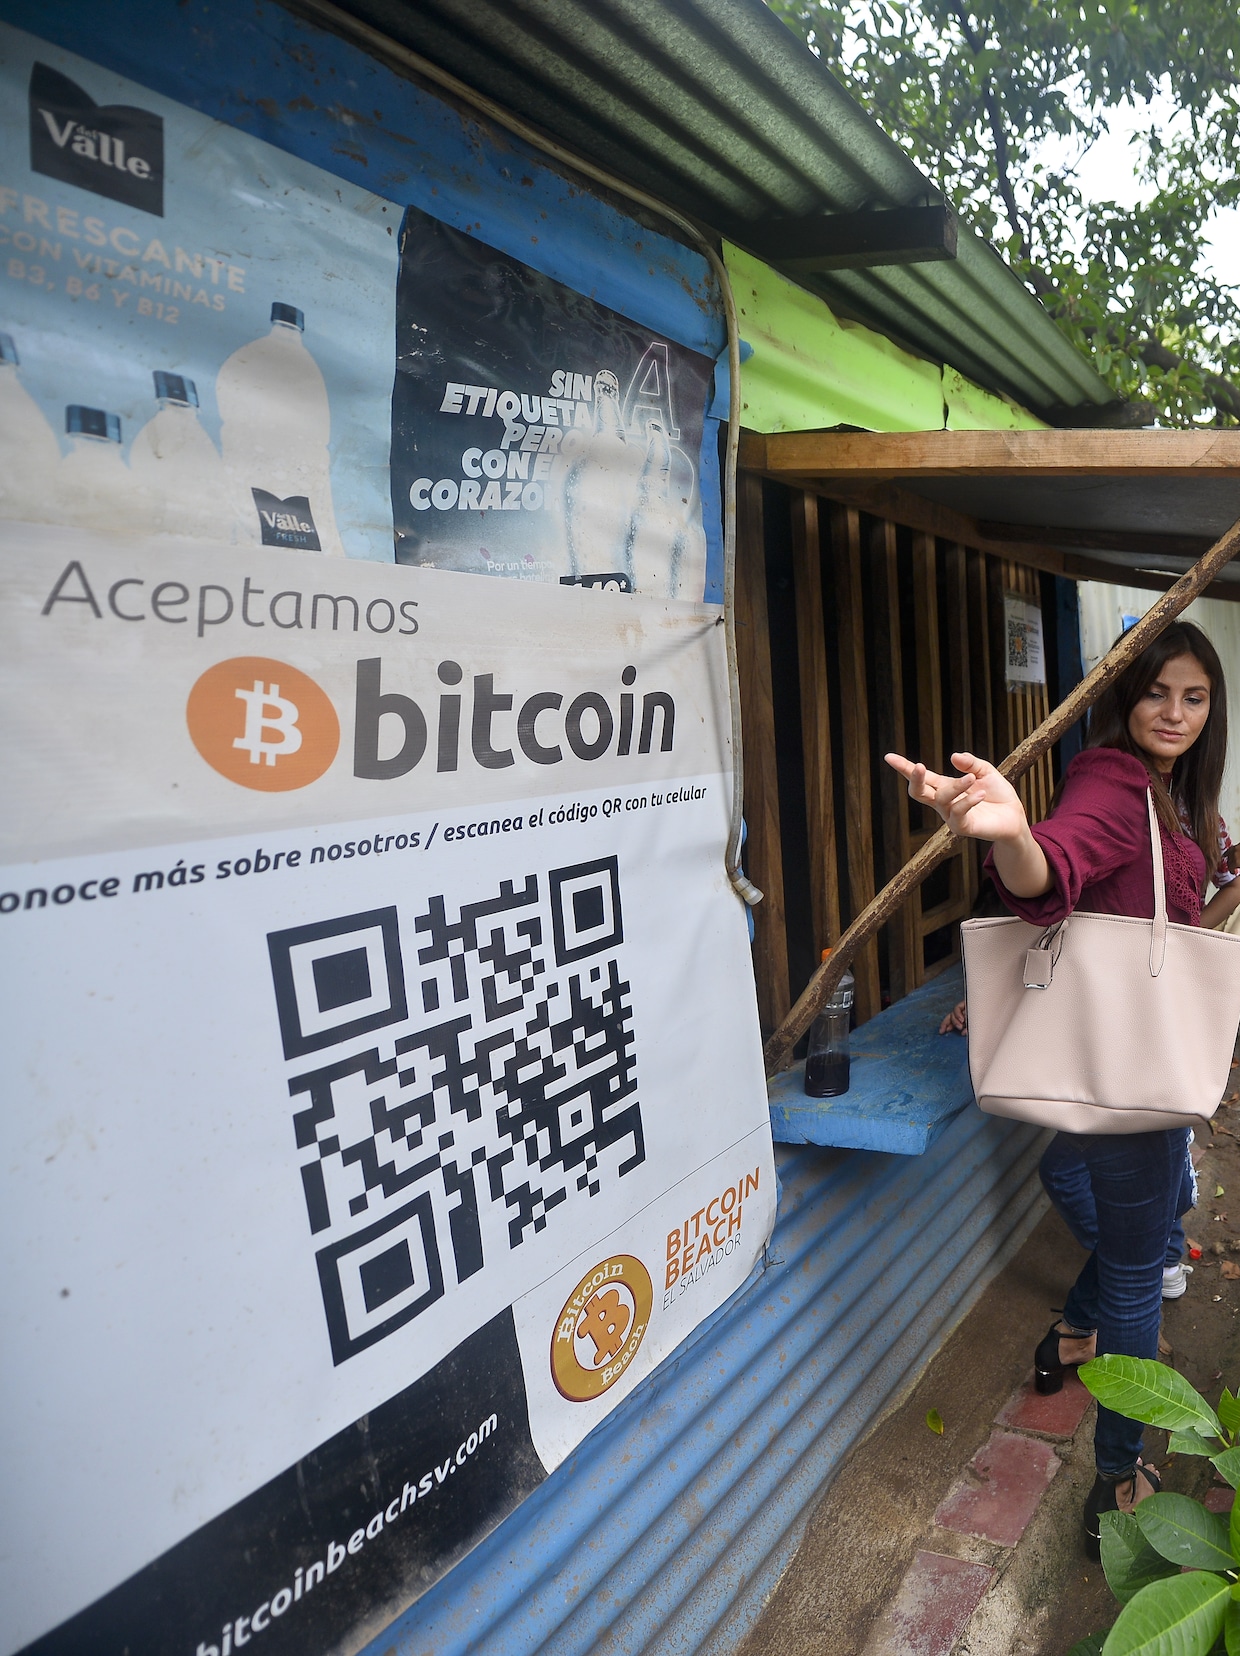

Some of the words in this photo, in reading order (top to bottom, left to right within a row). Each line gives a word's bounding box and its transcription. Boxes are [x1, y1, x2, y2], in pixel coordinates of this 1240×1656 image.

[38, 108, 151, 179] Valle
[8, 258, 55, 291] B3,
[66, 276, 100, 301] B6
[111, 289, 129, 307] Y
[137, 297, 180, 324] B12
[72, 247, 226, 312] VITAMINAS
[440, 382, 594, 429] ETIQUETA
[549, 369, 593, 401] SIN
[461, 447, 530, 479] CON
[500, 419, 584, 454] PERO
[260, 510, 312, 533] Valle
[276, 532, 307, 543] FRESH
[487, 560, 505, 571] Por
[507, 562, 519, 570] un
[40, 560, 420, 638] Aceptamos
[353, 657, 676, 780] bitcoin
[132, 859, 205, 893] más
[216, 848, 301, 880] sobre
[310, 832, 420, 864] nosotros
[424, 822, 439, 850] /
[443, 816, 523, 842] escanea
[528, 808, 544, 827] el
[548, 804, 598, 826] código
[602, 798, 621, 819] QR
[625, 796, 647, 811] con
[651, 792, 663, 806] tu
[666, 785, 708, 804] celular
[666, 1166, 760, 1261] BITCOIN
[663, 1288, 676, 1311] EL
[680, 1232, 741, 1296] SALVADOR
[665, 1205, 742, 1291] BEACH
[557, 1262, 624, 1343] Bitcoin
[601, 1323, 645, 1386] Beach
